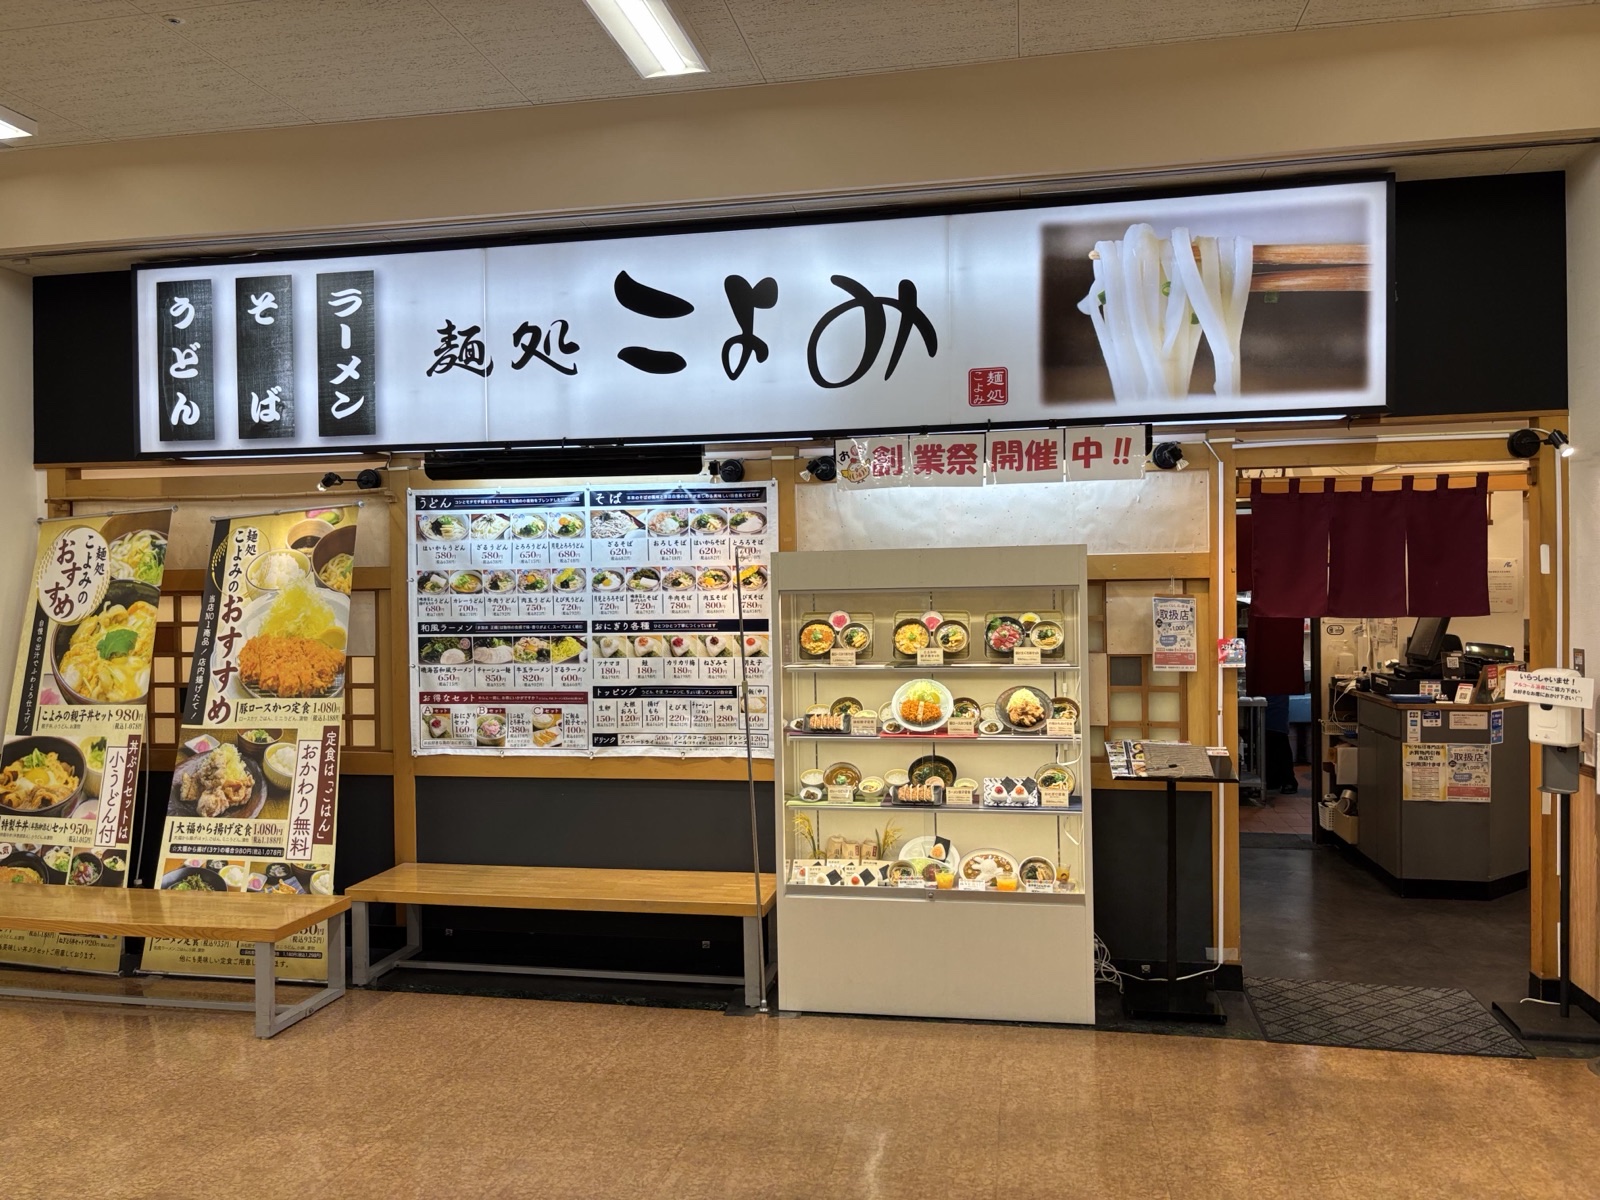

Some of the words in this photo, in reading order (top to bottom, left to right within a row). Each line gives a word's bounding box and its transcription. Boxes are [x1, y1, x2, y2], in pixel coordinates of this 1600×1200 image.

[426, 318, 580, 378] 麺処
[614, 269, 938, 388] こよみ
[170, 296, 201, 426] うどん
[247, 291, 282, 424] そば
[328, 288, 365, 420] ラーメン
[973, 371, 985, 404] こよみ
[986, 371, 1005, 403] 麺処
[420, 497, 452, 509] うどん
[595, 492, 623, 505] そば
[245, 529, 258, 556] 麺処
[77, 535, 94, 605] こよみの
[228, 530, 244, 592] こよみの
[44, 538, 82, 619] おすすめ
[421, 624, 473, 632] 和風ラーメン
[594, 621, 650, 631] おにぎり各種
[1160, 609, 1190, 621] 取扱店
[207, 594, 243, 725] おすすめ
[239, 701, 310, 714] 豚ロースかつ定食
[422, 694, 476, 702] お得なセット
[596, 687, 637, 696] トッピング
[42, 709, 113, 722] こよみの親子丼セット
[115, 708, 143, 721] 980円
[1453, 752, 1484, 762] 取扱店
[99, 751, 125, 844] 小うどん付
[119, 740, 138, 839] 丼ぶりセットは
[290, 744, 318, 857] おかわり無料
[316, 730, 337, 839] 定食は「ごはん」
[69, 823, 93, 835] 950円
[175, 821, 252, 836] 大福から揚げ定食
